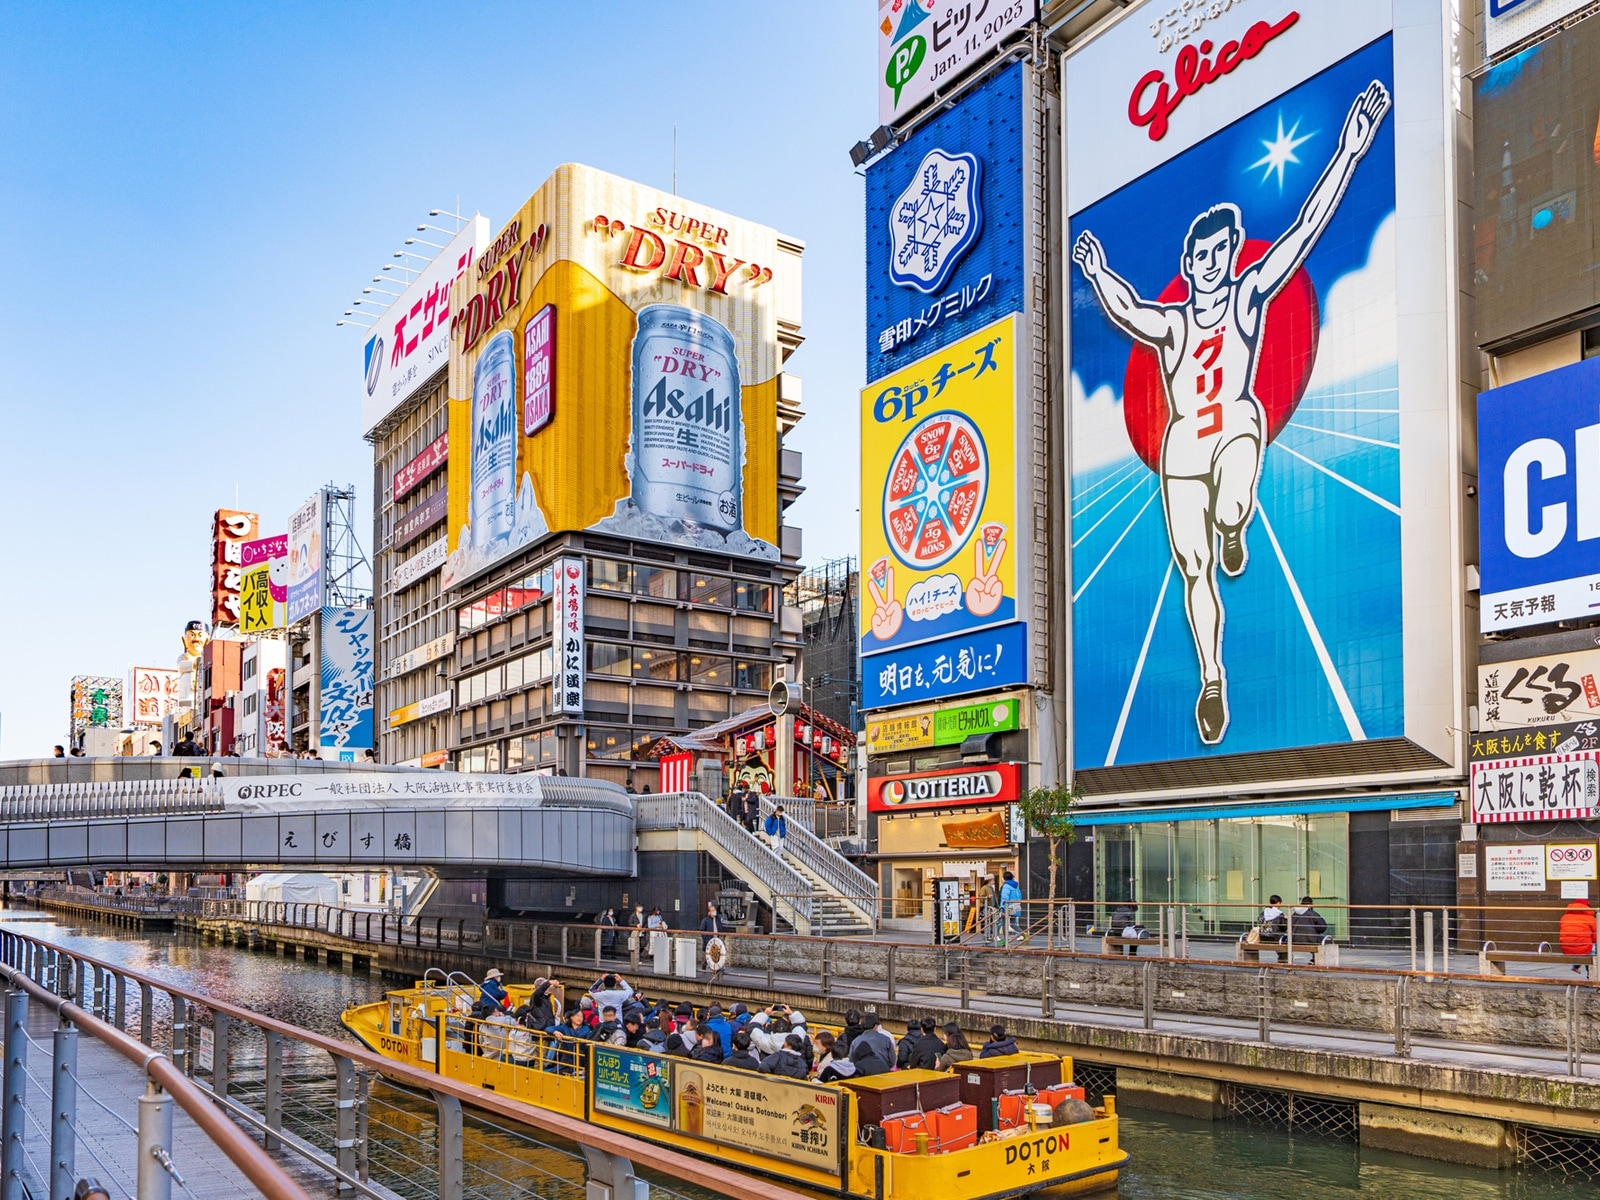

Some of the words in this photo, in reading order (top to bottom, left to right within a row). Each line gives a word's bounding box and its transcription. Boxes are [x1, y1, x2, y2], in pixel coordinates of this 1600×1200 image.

[930, 54, 962, 82] Jan.
[964, 34, 981, 56] 11,
[984, 1, 1023, 41] 2023
[1128, 11, 1300, 141] Glico
[653, 207, 730, 247] SUPER
[477, 221, 520, 282] SUPER
[879, 273, 993, 353] 雪印メグミルク
[525, 316, 550, 357] ASAHI
[672, 347, 705, 362] SUPER
[525, 356, 550, 393] 1889
[1192, 325, 1226, 439] グリコ
[525, 393, 549, 429] OSAKA
[643, 376, 730, 434] Asahi
[475, 397, 512, 462] Asahi
[677, 428, 699, 448] 生
[920, 425, 946, 444] SNOW
[924, 444, 941, 455] 6P
[958, 434, 977, 465] SNOW
[662, 458, 715, 477] スーパードライ
[892, 457, 908, 493] SNOW
[675, 493, 700, 505] 生ビール
[959, 490, 976, 528] SNOW
[891, 516, 909, 546] SNOW
[920, 540, 945, 557] SNOW
[243, 572, 256, 630] バイト
[255, 570, 269, 627] 高収入
[567, 583, 580, 633] 本場の味
[909, 582, 959, 606] ハイ!チーズ
[1494, 594, 1556, 621] 天気予報
[335, 611, 375, 707] シャッターは
[566, 637, 580, 707] かに道楽
[879, 644, 1003, 697] 明日を、元気に!
[1501, 663, 1582, 715] くくる
[958, 707, 990, 730] ピタットハウス
[1527, 715, 1556, 723] KUKURU
[1472, 730, 1561, 757] 大阪もんを食す
[1581, 736, 1599, 749] 2F
[341, 753, 353, 762] BX
[315, 779, 399, 796] 一般社団法人
[908, 775, 989, 799] LOTTERIA
[1477, 764, 1582, 812] 大阪に乾杯
[1586, 768, 1597, 797] 検索
[283, 831, 413, 851] えびす橋
[380, 1037, 408, 1056] DOTON
[706, 1083, 728, 1094] ようこそ!
[815, 1094, 836, 1106] KIRIN
[706, 1096, 733, 1108] Welcome!
[735, 1102, 754, 1113] Osaka
[756, 1107, 788, 1120] Dotonbori
[791, 1129, 828, 1147] 一番搾り
[791, 1142, 806, 1151] KIRIN
[807, 1146, 829, 1156] ICHIBAN
[1005, 1132, 1070, 1165] DOTON
[1027, 1159, 1050, 1176] 大阪
